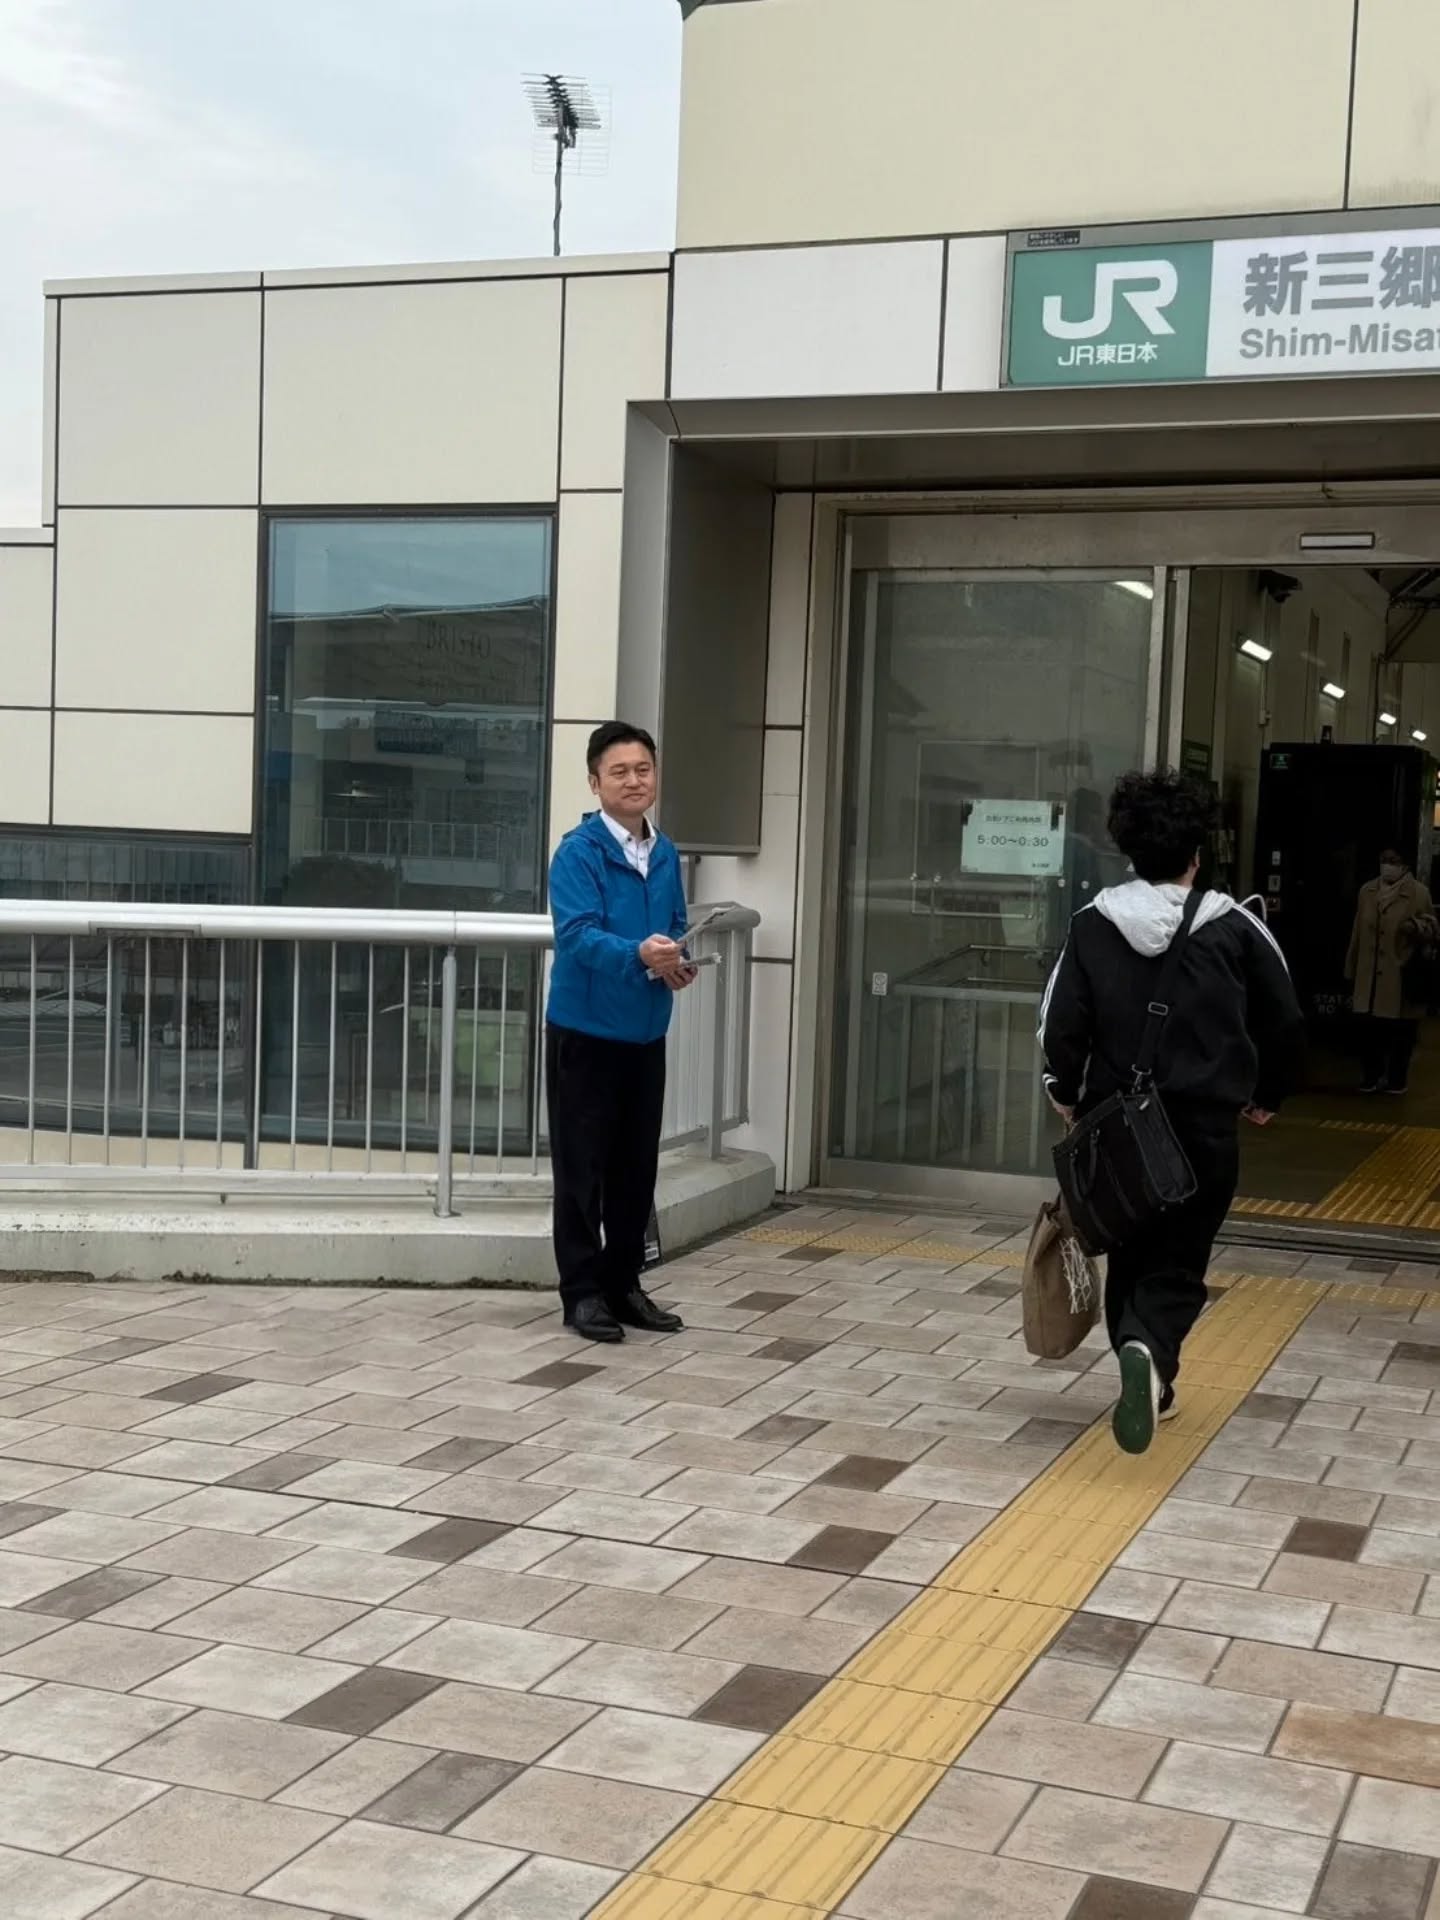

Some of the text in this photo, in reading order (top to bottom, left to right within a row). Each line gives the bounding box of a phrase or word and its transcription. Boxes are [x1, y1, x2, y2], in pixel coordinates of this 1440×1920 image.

[1041, 259, 1178, 340] JR
[1242, 246, 1440, 317] 新三郷
[1057, 341, 1159, 366] JR東日本
[1239, 322, 1440, 359] Shim-Misa
